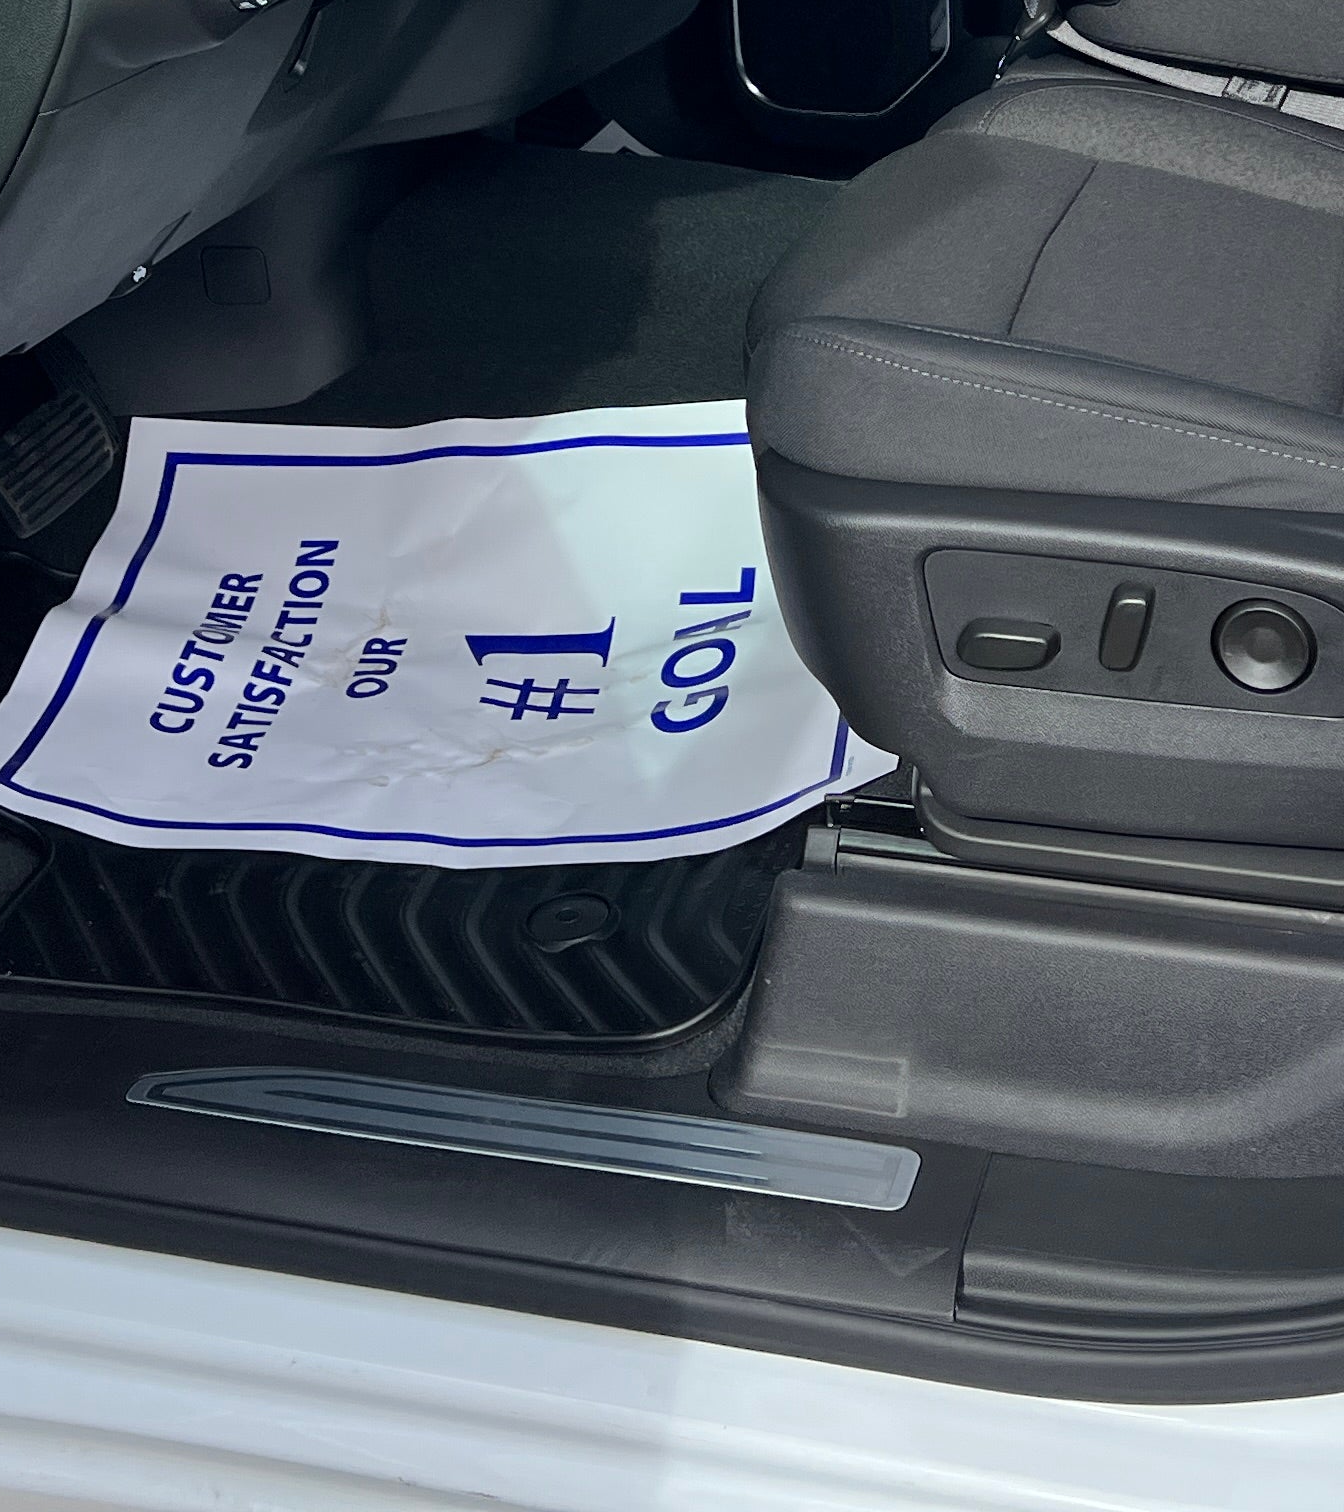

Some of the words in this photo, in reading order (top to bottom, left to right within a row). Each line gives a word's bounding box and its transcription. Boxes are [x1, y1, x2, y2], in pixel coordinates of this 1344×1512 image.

[149, 572, 264, 735] CUSTOMER
[208, 539, 340, 769] SATISFACTION
[346, 637, 408, 699] OUR
[464, 616, 616, 721] #1
[649, 566, 758, 734] GOAL
